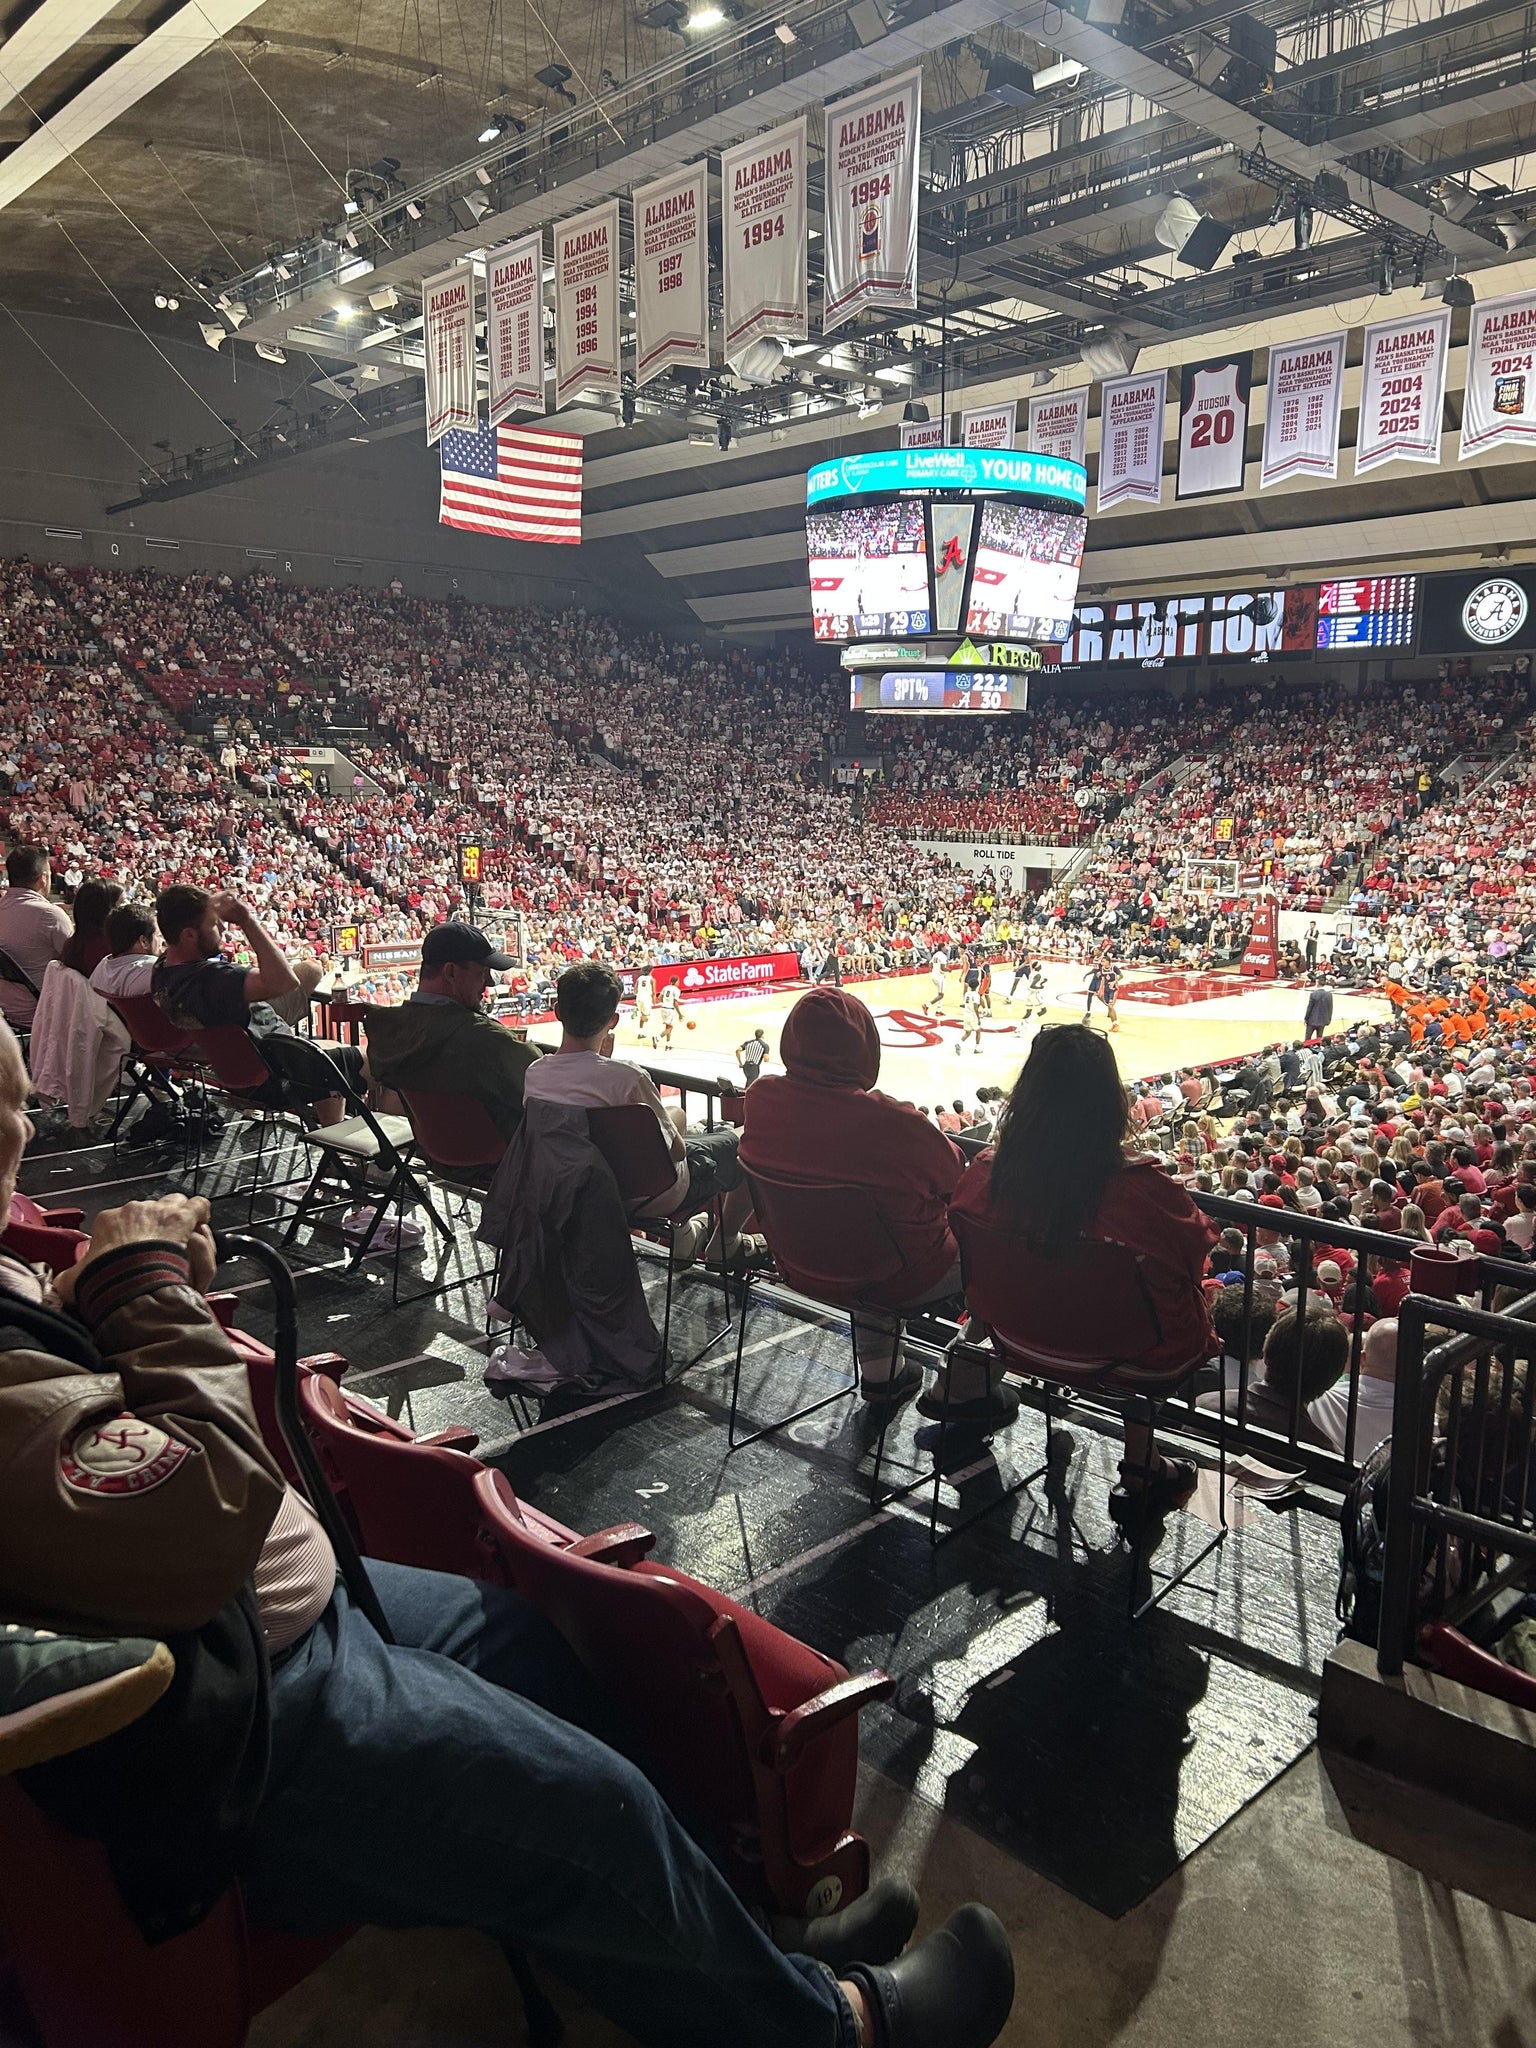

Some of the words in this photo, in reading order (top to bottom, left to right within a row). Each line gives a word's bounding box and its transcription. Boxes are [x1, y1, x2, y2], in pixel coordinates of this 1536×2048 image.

[839, 101, 905, 148] ALABAMA
[838, 155, 857, 170] NCAA
[858, 135, 906, 162] TOURNAMENT
[839, 142, 870, 159] WOMEN'S
[869, 127, 906, 148] BASKETBALL
[735, 148, 793, 191] ALABAMA
[847, 160, 872, 178] FINAL
[874, 150, 896, 168] FOUR
[734, 186, 759, 203] WOMEN'S
[759, 172, 794, 192] BASKETBALL
[734, 197, 751, 212] NCAA
[751, 180, 794, 205] TOURNAMENT
[850, 173, 891, 208] 1994
[645, 189, 696, 228] ALABAMA
[741, 202, 763, 219] ELITE
[764, 192, 786, 210] EIGHT
[643, 234, 660, 248] NCAA
[660, 220, 697, 241] TOURNAMENT
[644, 223, 665, 239] WOMEN'S
[666, 212, 697, 230] BASKETBALL
[743, 214, 785, 249] 1994
[563, 226, 608, 260] ALABAMA
[645, 240, 667, 257] SWEET
[668, 228, 697, 248] SIXTEEN
[563, 256, 582, 269] WOMEN'S
[582, 247, 609, 262] BASKETBALL
[563, 265, 576, 277] NCAA
[577, 254, 609, 272] TOURNAMENT
[658, 252, 683, 275] 1997
[494, 256, 533, 288] ALABAMA
[563, 271, 583, 287] SWEET
[584, 262, 609, 279] SIXTEEN
[658, 271, 683, 294] 1998
[431, 285, 466, 313] ALABAMA
[491, 283, 510, 297] WOMEN'S
[505, 283, 534, 299] TOURNAMENT
[575, 284, 597, 305] 1984
[496, 292, 532, 312] APPEARANCES
[575, 302, 597, 322] 1994
[576, 319, 598, 339] 1995
[1482, 332, 1503, 344] MEN'S
[576, 337, 598, 356] 1996
[1376, 329, 1435, 355] ALABAMA
[1480, 340, 1500, 351] NCAA
[1489, 344, 1514, 356] FINAL
[1279, 350, 1333, 374] ALABAMA
[1374, 359, 1391, 370] NCAA
[1391, 352, 1435, 366] TOURNAMENT
[1375, 352, 1394, 364] MEN'S
[1395, 345, 1435, 359] BASKETBALL
[1490, 354, 1533, 376] 2024
[1278, 371, 1296, 383] MEN'S
[1296, 366, 1333, 380] BASKETBALL
[1380, 364, 1403, 376] ELITE
[1404, 360, 1427, 371] EIGHT
[1277, 379, 1293, 389] NCAA
[1293, 371, 1333, 385] TOURNAMENT
[1277, 384, 1302, 395] SWEET
[1302, 378, 1332, 391] SIXTEEN
[1380, 375, 1423, 397] 2004
[1111, 387, 1155, 408] ALABAMA
[1197, 394, 1231, 412] HUDSON
[1379, 394, 1422, 417] 2024
[1037, 402, 1078, 422] ALABAMA
[1110, 407, 1125, 415] MEN'S
[1111, 413, 1154, 426] APPEARANCES
[969, 416, 1008, 434] ALABAMA
[1190, 408, 1235, 449] 20
[1377, 414, 1420, 436] 2025
[907, 429, 943, 447] ALABAMA
[905, 452, 965, 470] LiveWell
[905, 469, 940, 479] PRIMARY
[941, 469, 961, 478] CARE
[981, 458, 1032, 483] YOUR
[1034, 463, 1073, 490] HOME
[110, 544, 119, 556] Q
[285, 561, 293, 572] R
[452, 578, 459, 589] S
[1470, 585, 1520, 609] ALABAMA
[830, 613, 850, 634] 45
[889, 611, 909, 632] 29
[984, 610, 1002, 632] 45
[1037, 617, 1054, 636] 29
[1468, 614, 1501, 638] CRIMSON
[1500, 613, 1519, 634] TIDE
[898, 647, 921, 658] Trust
[1141, 657, 1165, 669] Coca-Cola
[1040, 663, 1062, 674] ALFA
[894, 678, 929, 702] 3PT%
[971, 673, 1008, 693] 22.2
[979, 691, 1001, 709] 30
[1215, 826, 1230, 839] 28
[973, 849, 995, 859] ROLL
[996, 851, 1015, 860] TIDE
[463, 857, 477, 878] 28
[373, 950, 417, 960] NISSAN
[1243, 951, 1272, 965] Coca-Cola
[634, 1481, 670, 1499] 2
